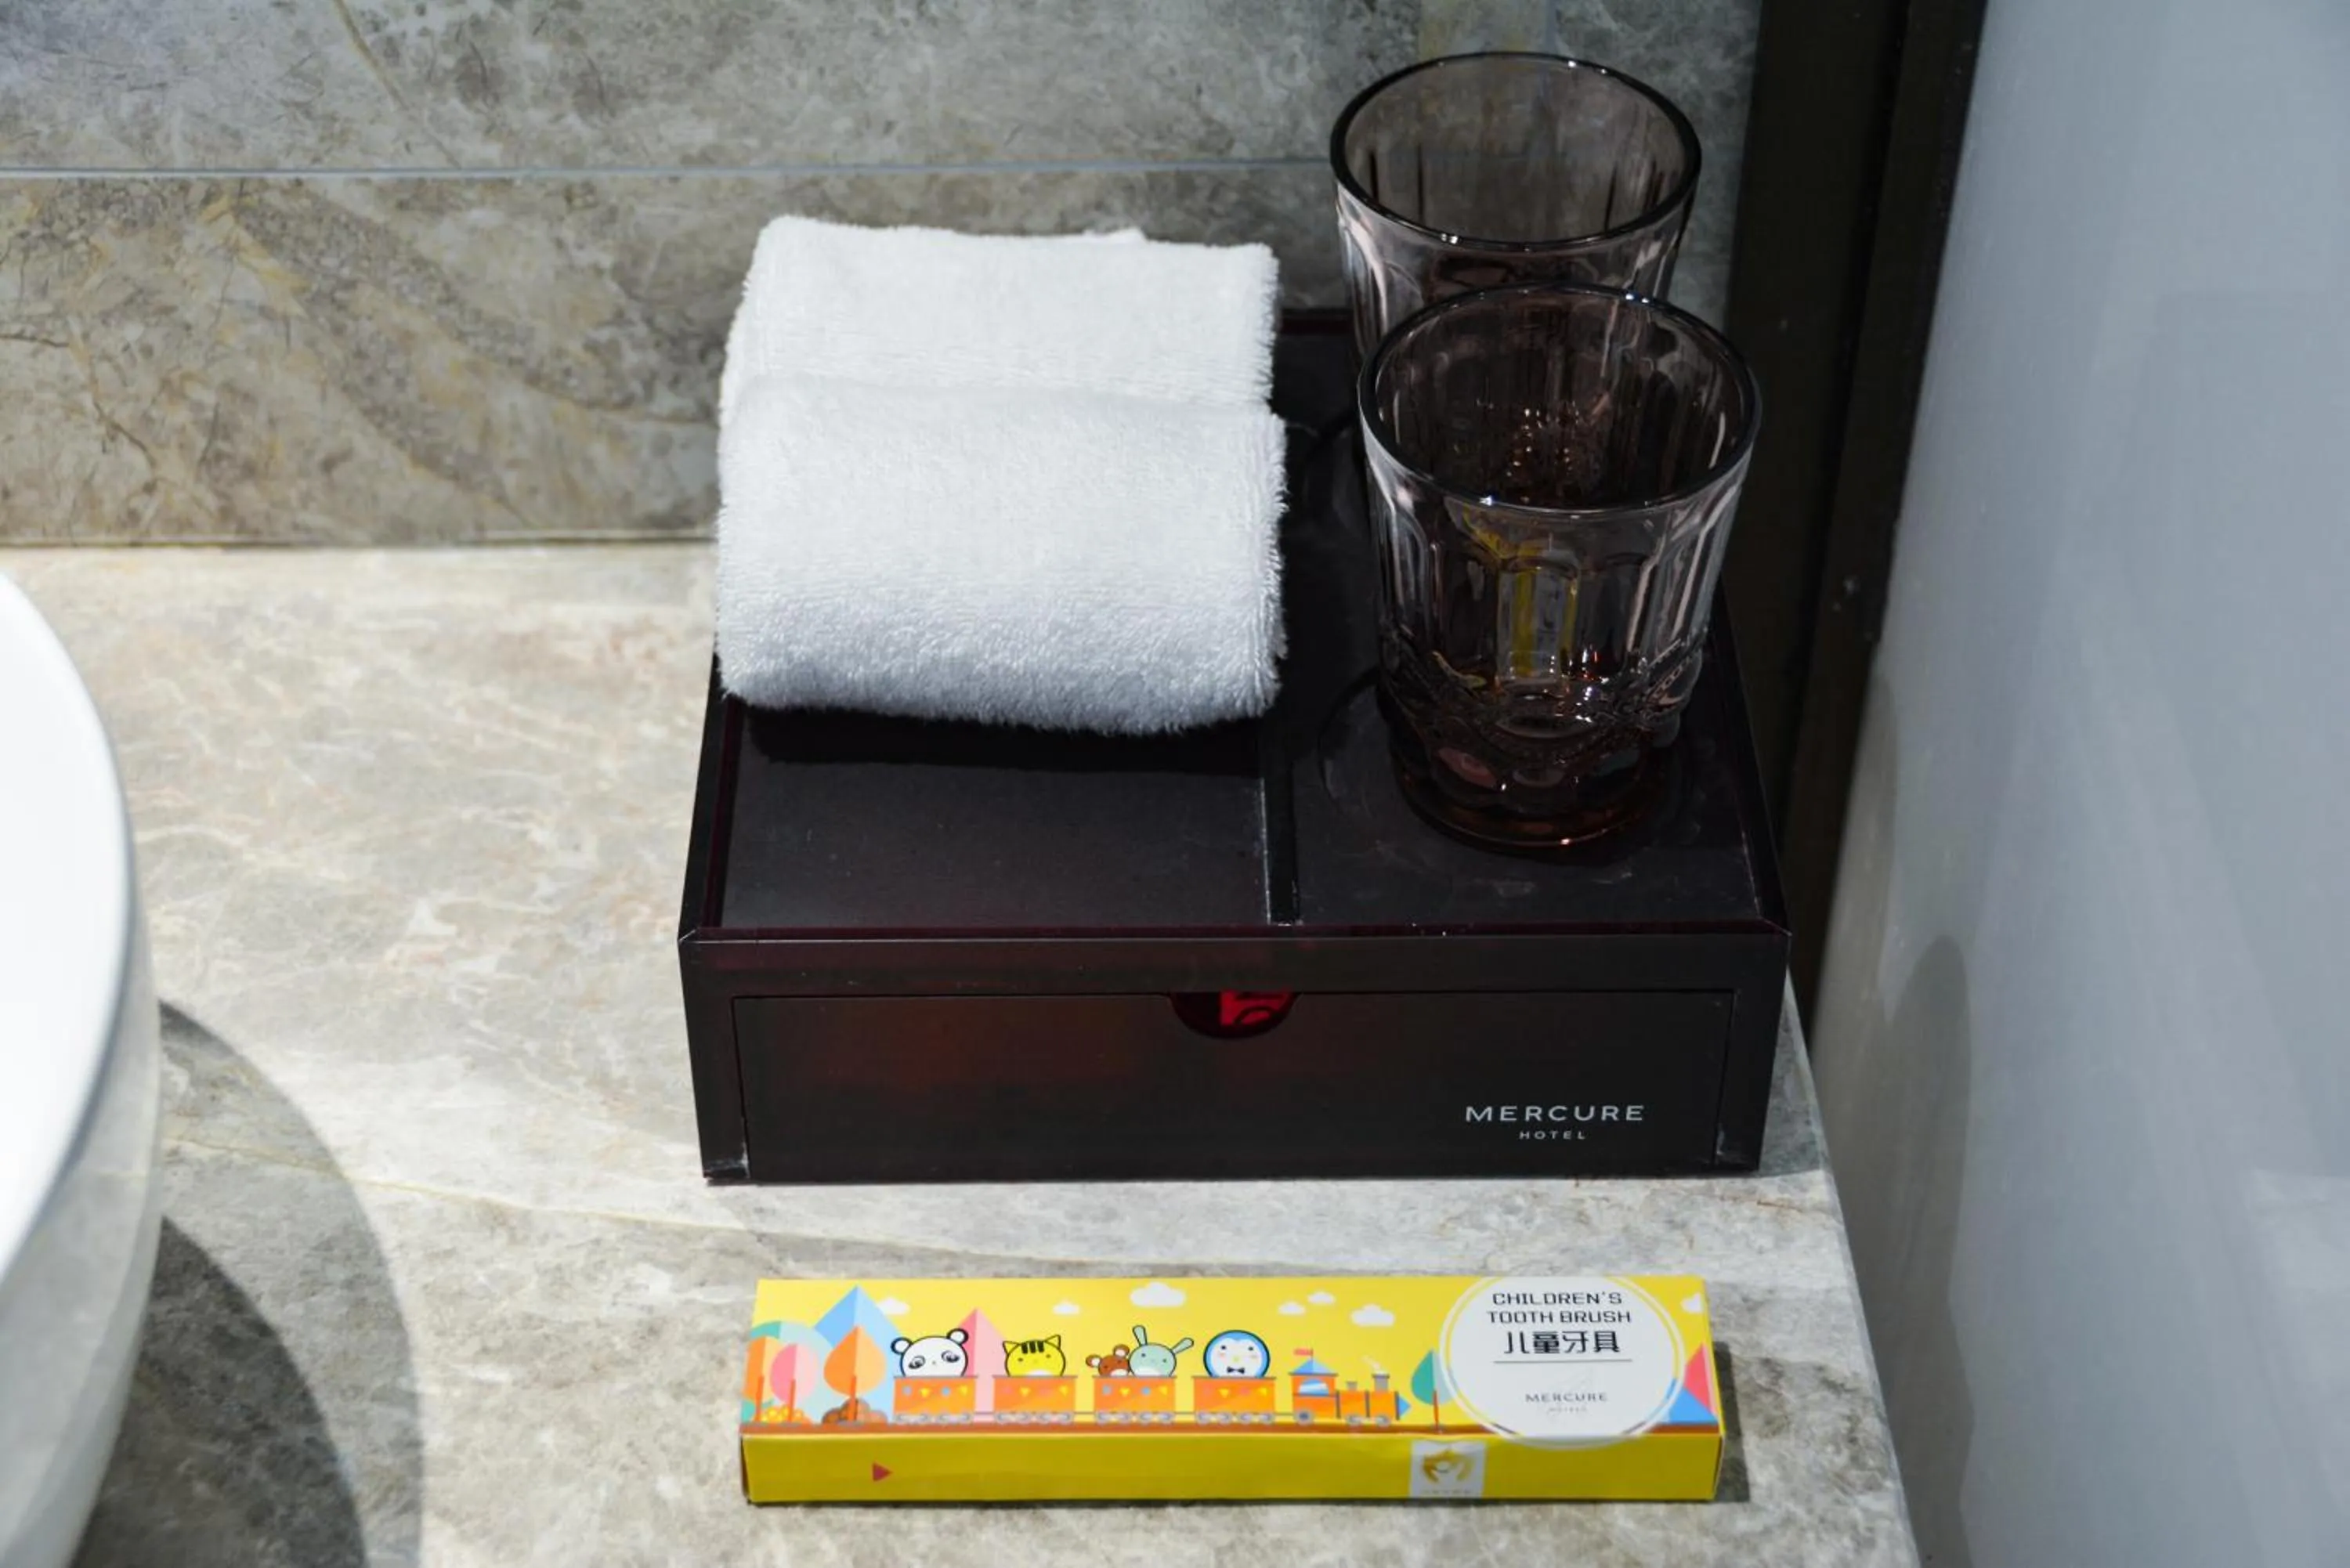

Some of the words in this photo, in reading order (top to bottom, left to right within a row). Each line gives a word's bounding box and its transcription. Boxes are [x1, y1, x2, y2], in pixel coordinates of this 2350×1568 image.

[1465, 1105, 1644, 1122] MERCURE
[1518, 1130, 1586, 1140] HOTEL
[1491, 1292, 1622, 1306] CHILDREN'S
[1487, 1310, 1553, 1324] TOOTH
[1560, 1310, 1631, 1324] BRUSH
[1503, 1330, 1621, 1354] 儿童牙具
[1524, 1392, 1608, 1403] MERCURE
